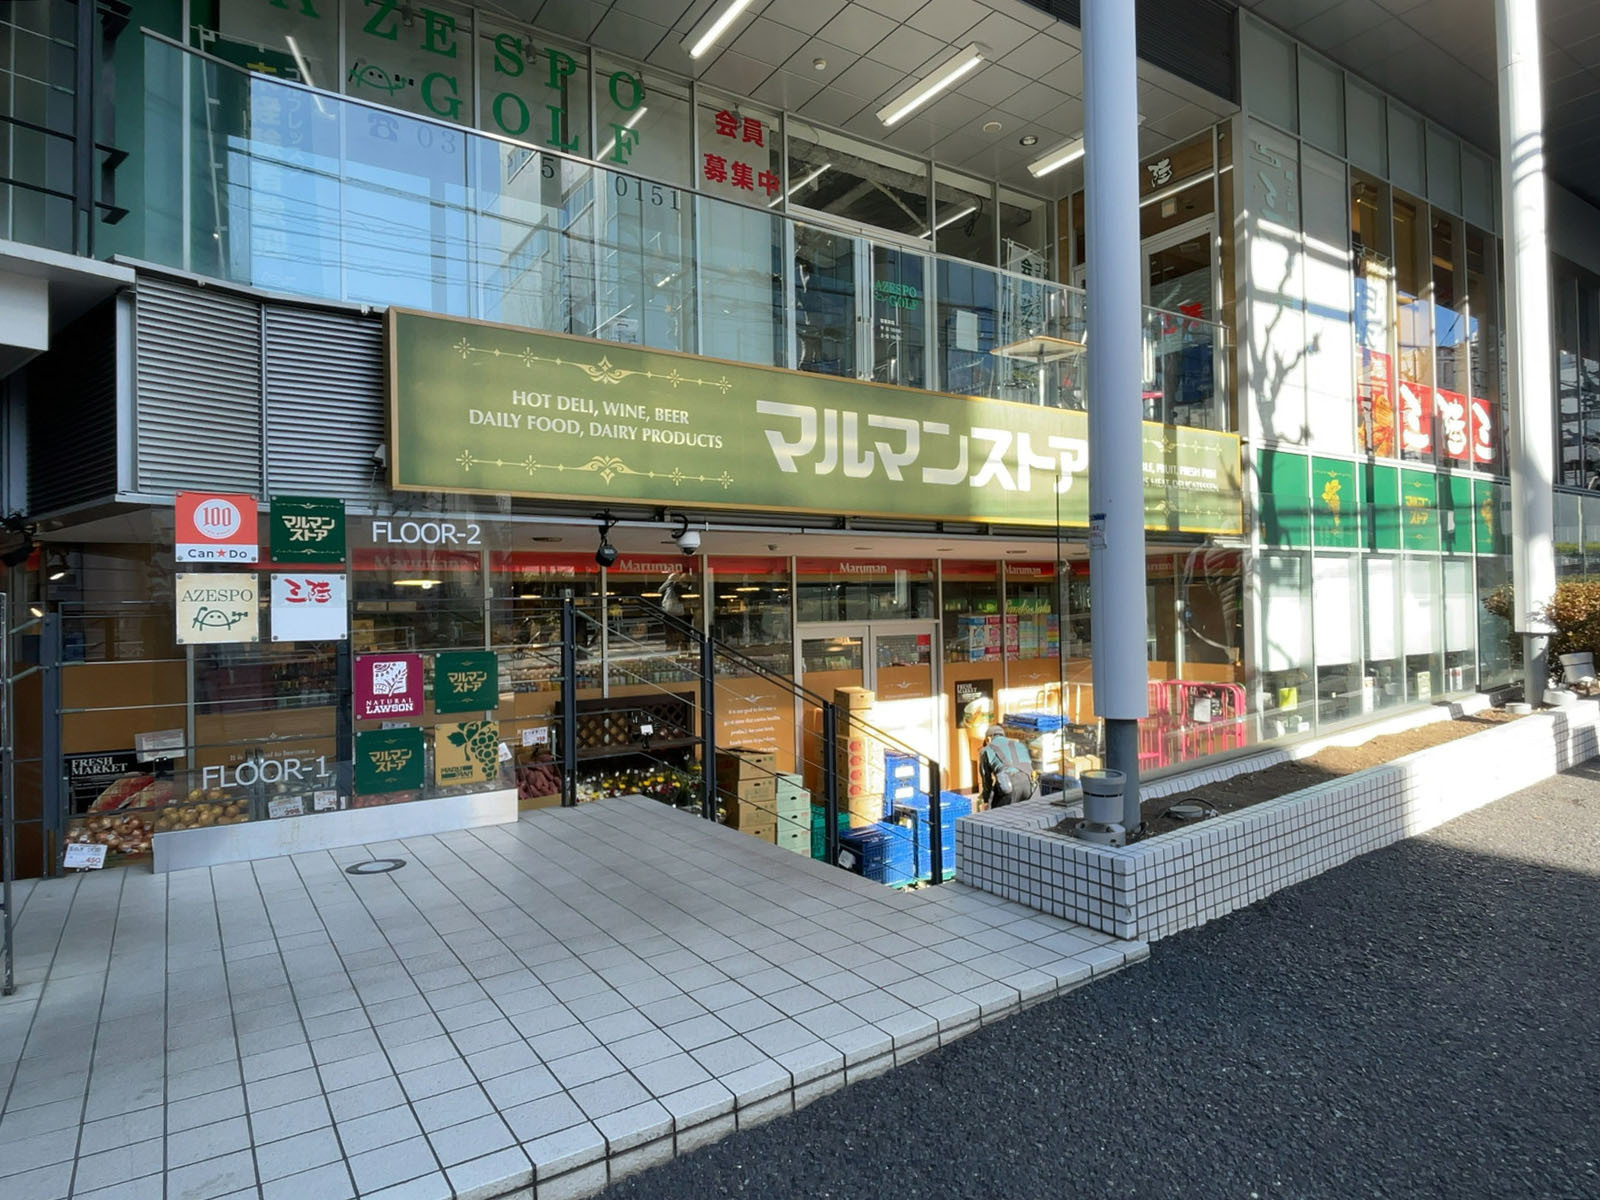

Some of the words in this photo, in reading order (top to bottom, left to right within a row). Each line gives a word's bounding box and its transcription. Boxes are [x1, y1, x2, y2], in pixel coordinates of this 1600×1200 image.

[421, 72, 640, 165] GOLF
[715, 109, 765, 148] 会員
[703, 153, 780, 198] 募集中
[615, 176, 680, 210] 0151
[512, 390, 551, 409] HOT
[557, 395, 599, 417] DELI,
[602, 401, 650, 424] WINE,
[655, 407, 689, 425] BEER
[468, 409, 521, 429] DAILY
[527, 415, 584, 438] FOOD,
[589, 422, 637, 441] DAIRY
[642, 428, 723, 449] PRODUCTS
[755, 399, 1088, 494] マルマンストア
[203, 507, 232, 527] 100
[281, 515, 335, 529] マルマン
[289, 528, 328, 542] ストア
[372, 521, 482, 545] FLOOR-2
[188, 549, 214, 559] Can
[229, 550, 248, 559] Do
[619, 559, 683, 573] Maruman
[839, 562, 887, 574] Maruman
[181, 589, 254, 603] AZESPO
[447, 671, 487, 683] マルマン
[453, 682, 482, 693] ストア
[366, 697, 414, 706] NATURAL
[366, 703, 414, 714] LAWSON
[72, 756, 113, 768] FRESH
[368, 749, 412, 762] マルマン
[72, 763, 128, 776] MARKET
[202, 756, 330, 790] FLOOR-1
[375, 759, 407, 773] ストア
